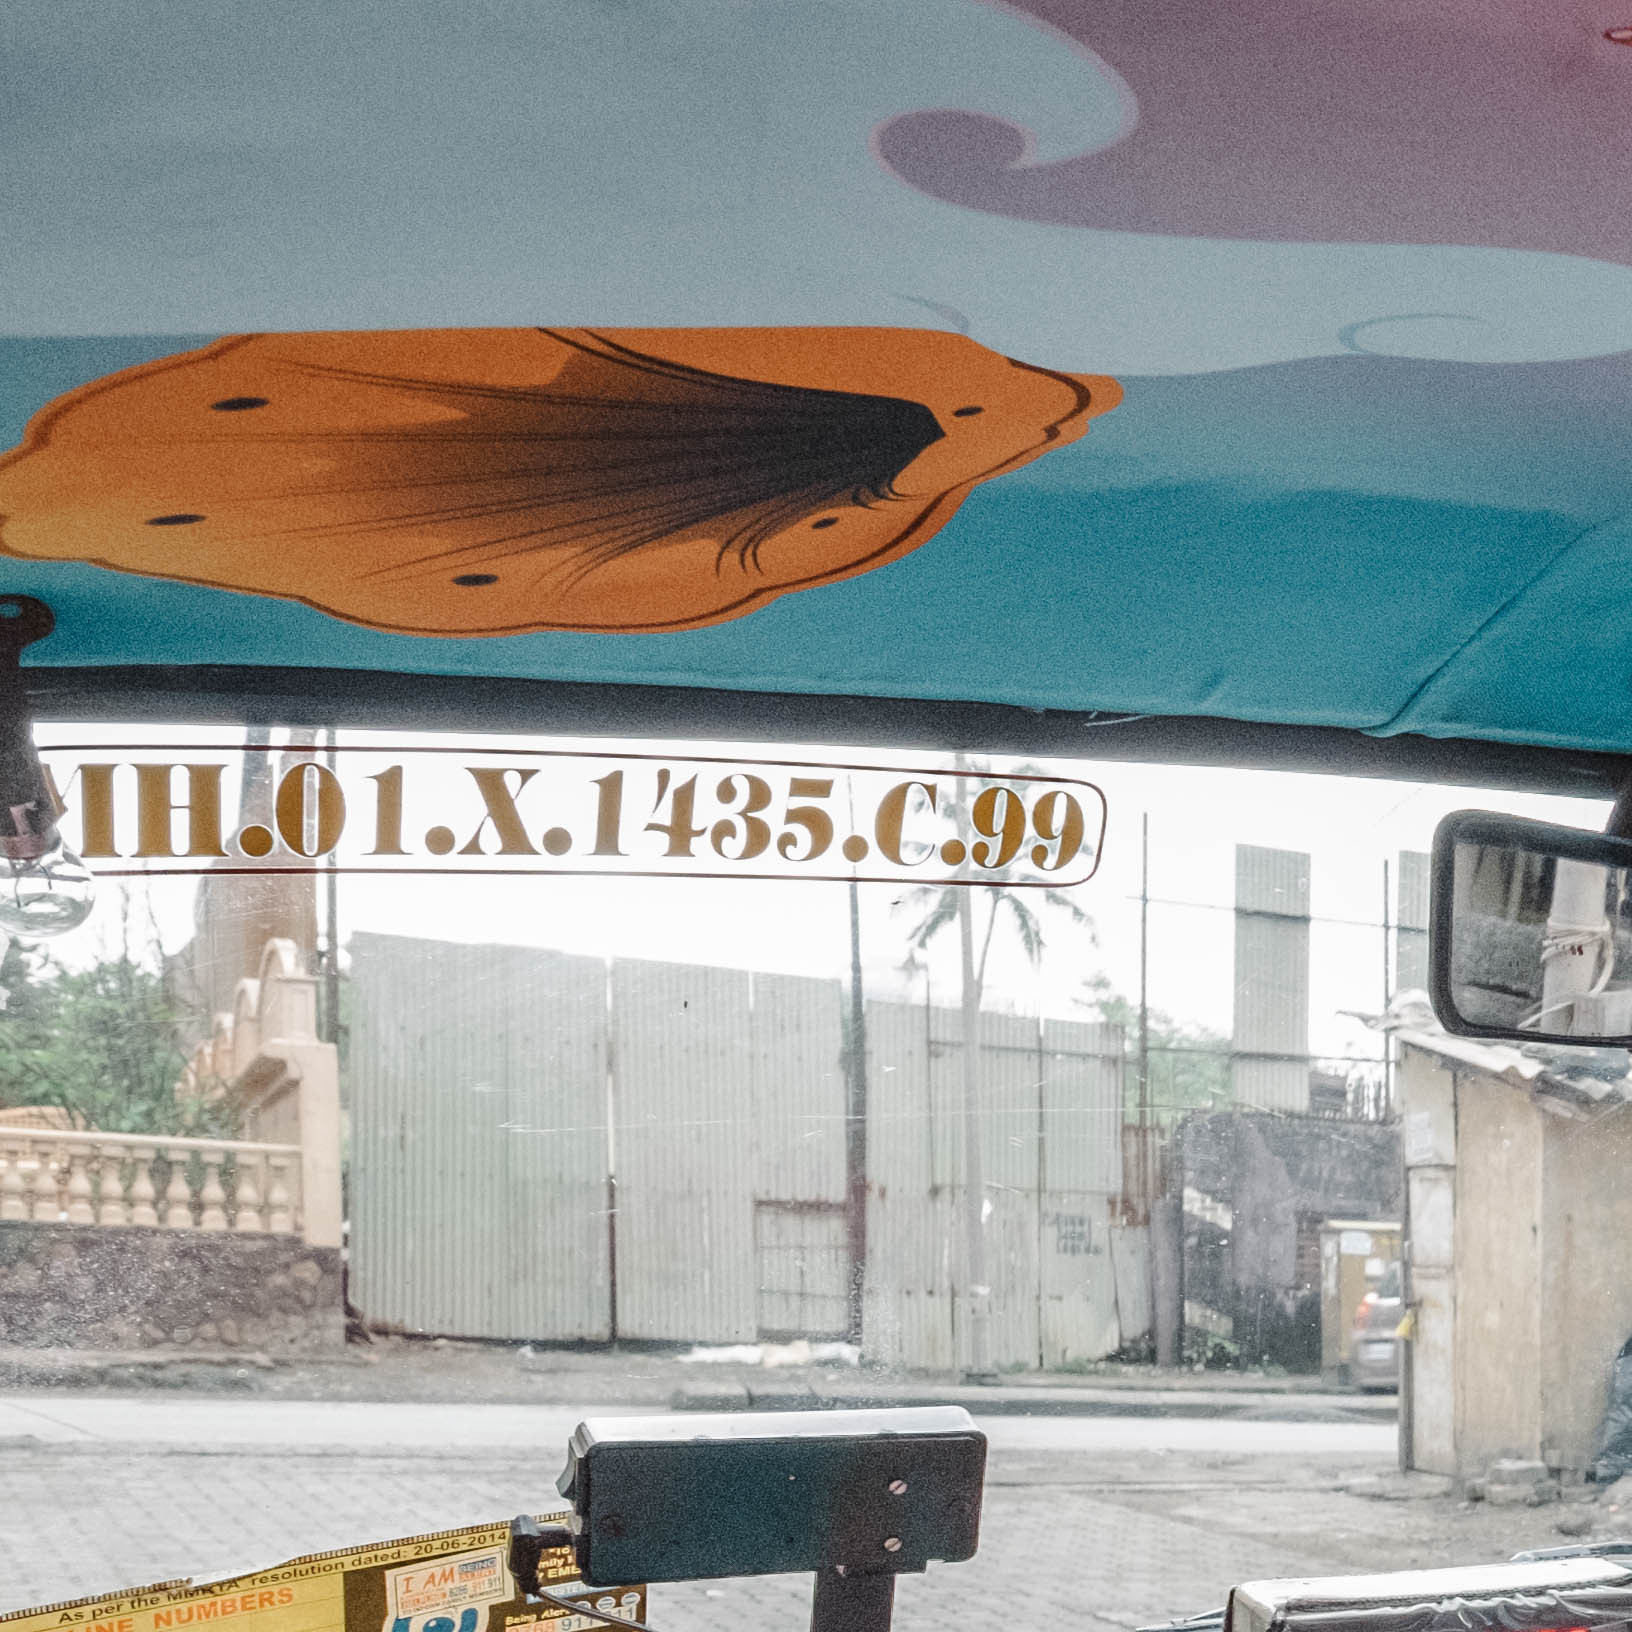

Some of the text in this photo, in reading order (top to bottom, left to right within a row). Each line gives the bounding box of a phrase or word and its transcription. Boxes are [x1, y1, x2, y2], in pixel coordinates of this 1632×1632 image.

[58, 1611, 85, 1624] As
[92, 1602, 125, 1620] per
[130, 1595, 160, 1610] the
[250, 1559, 345, 1586] resolution
[351, 1549, 408, 1567] dated:
[414, 1531, 507, 1556] 20-06-2014
[402, 1576, 415, 1595] I
[423, 1566, 456, 1592] AM
[153, 1586, 294, 1630] NUMBERS
[505, 1613, 538, 1626] Being
